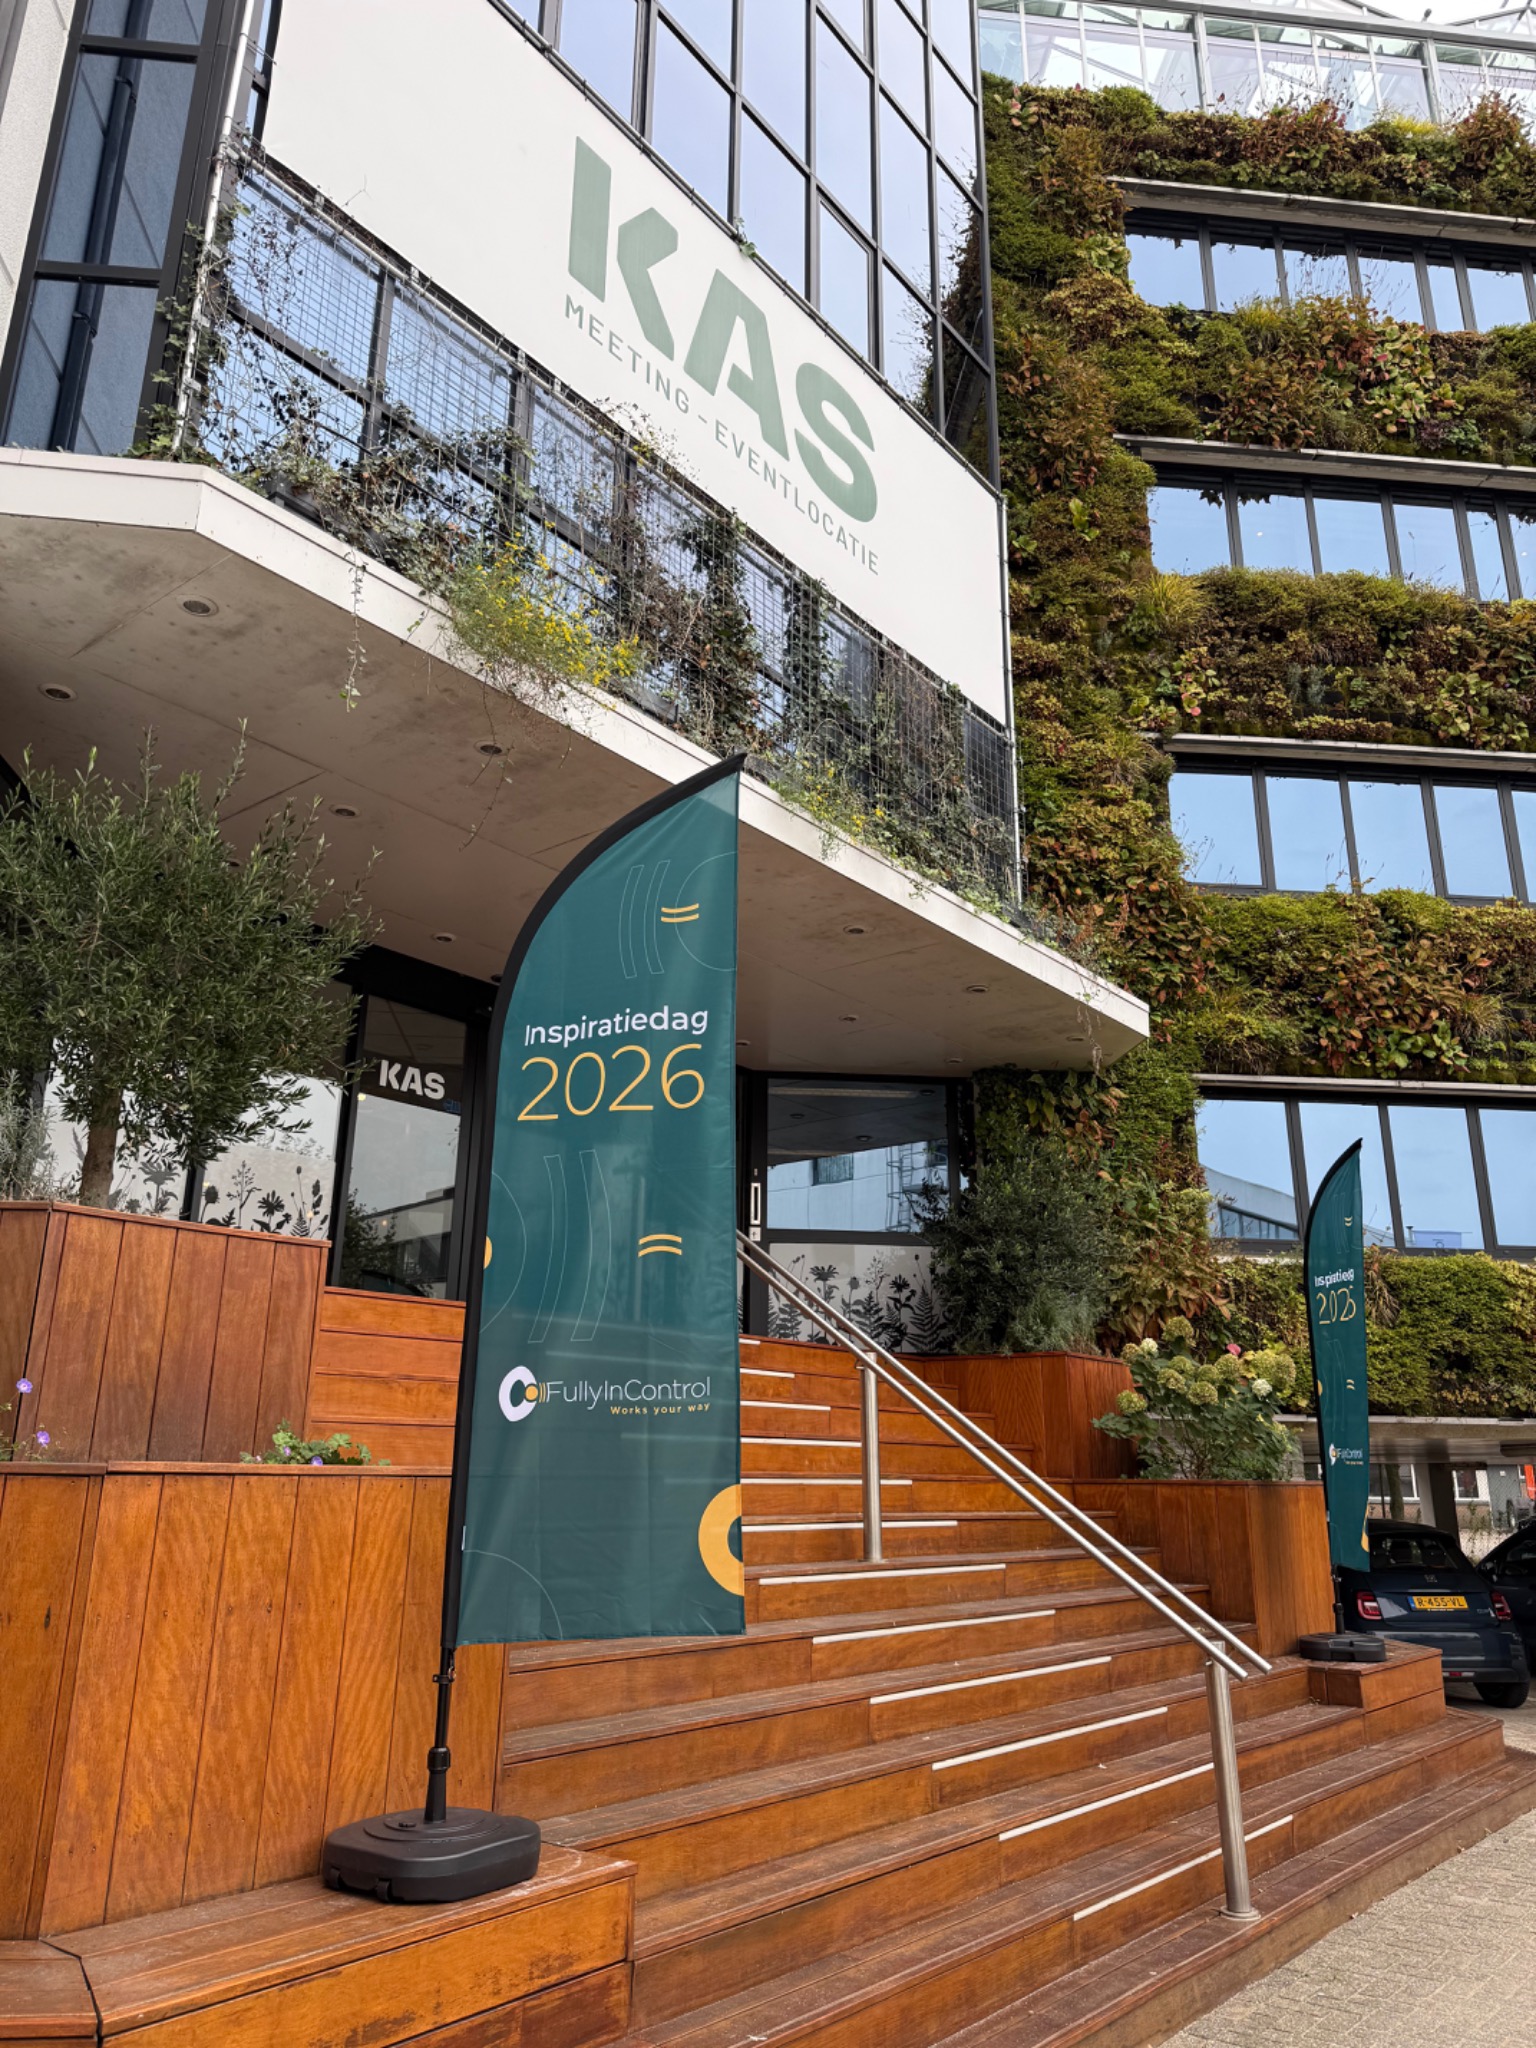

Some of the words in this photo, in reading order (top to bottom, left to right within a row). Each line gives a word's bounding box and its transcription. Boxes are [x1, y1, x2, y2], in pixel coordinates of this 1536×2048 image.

[568, 136, 878, 523] KAS
[565, 294, 690, 414] MEETING
[714, 417, 879, 576] EVENTLOCATIE
[524, 1005, 709, 1048] Inspiratiedag
[379, 1059, 446, 1100] KAS
[517, 1043, 705, 1122] 2026
[546, 1376, 711, 1411] FullyInControl
[610, 1405, 648, 1416] Works
[653, 1405, 682, 1416] your
[688, 1402, 711, 1413] way
